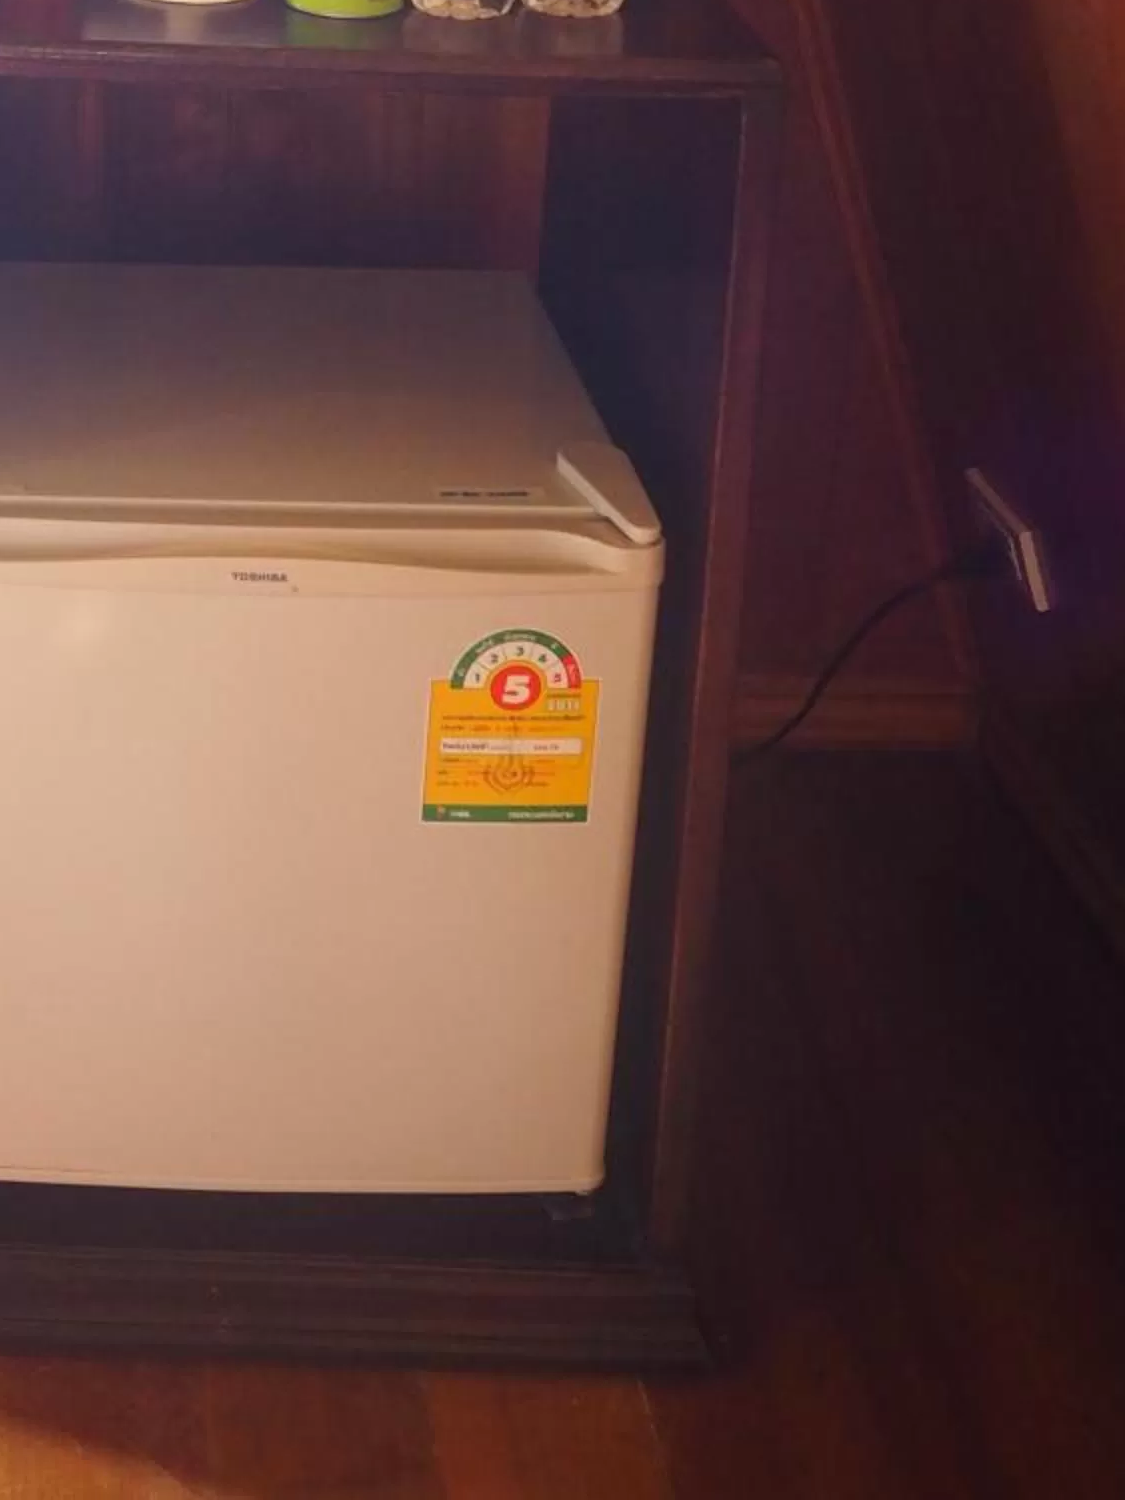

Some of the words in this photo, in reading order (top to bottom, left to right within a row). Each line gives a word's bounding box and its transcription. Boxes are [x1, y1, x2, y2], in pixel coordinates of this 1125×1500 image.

[231, 571, 288, 582] TOSHIBA
[515, 646, 525, 657] 3
[501, 674, 532, 705] 5
